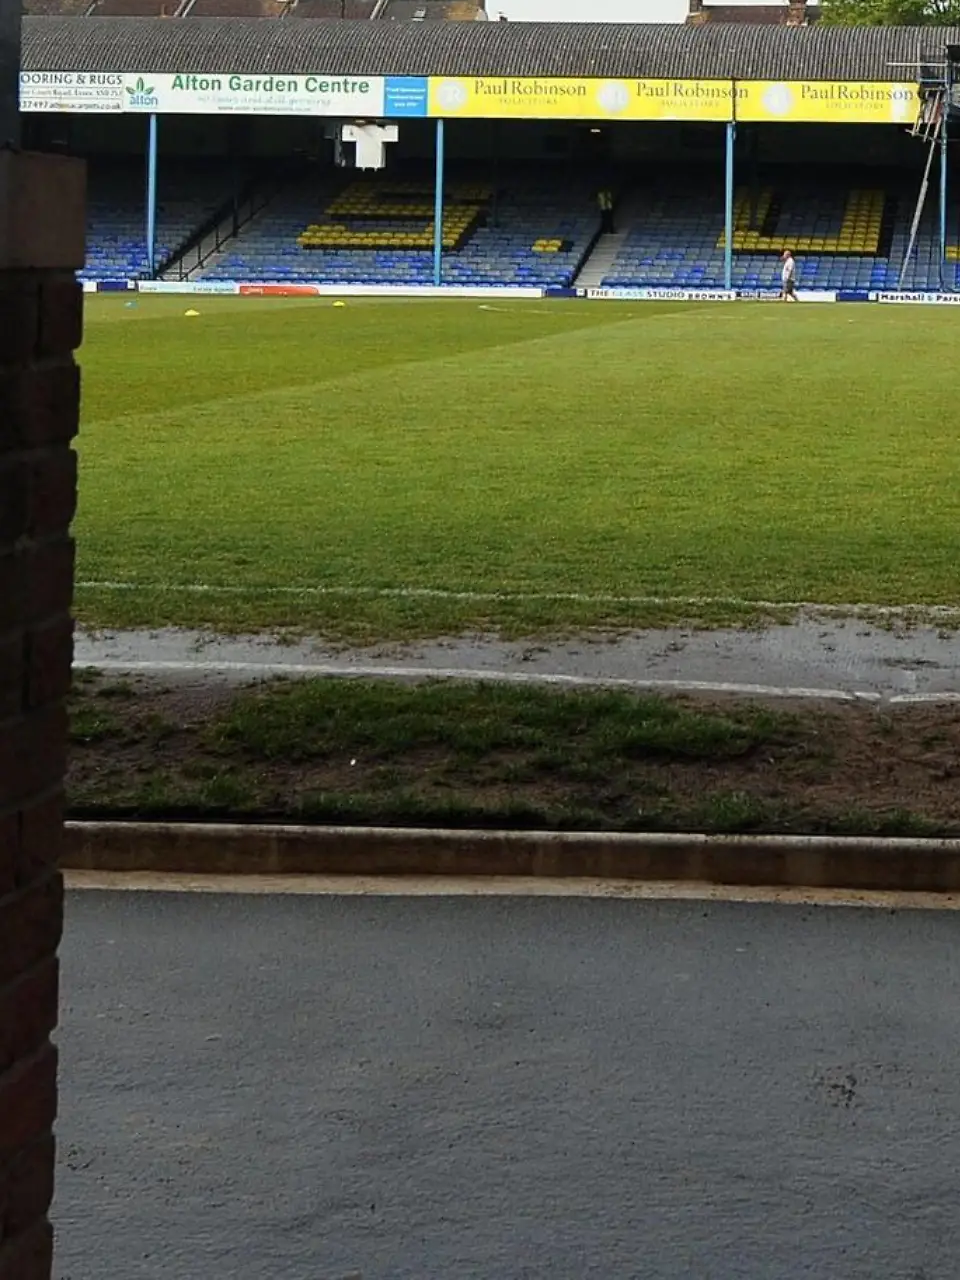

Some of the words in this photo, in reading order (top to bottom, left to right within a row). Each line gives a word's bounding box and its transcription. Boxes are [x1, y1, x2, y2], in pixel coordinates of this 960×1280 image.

[76, 74, 86, 85] &
[89, 74, 123, 85] RUGS
[171, 75, 221, 91] Alton
[228, 76, 298, 92] Garden
[305, 77, 370, 93] Centre
[474, 79, 507, 95] Paul
[511, 80, 587, 96] Robinson
[636, 82, 670, 97] Paul
[673, 82, 749, 99] Robinson
[801, 84, 834, 99] Paul
[837, 84, 914, 101] Robinson
[129, 94, 158, 106] alton
[590, 290, 609, 298] THE
[647, 291, 685, 299] STUDIO
[881, 292, 925, 300] Marshall
